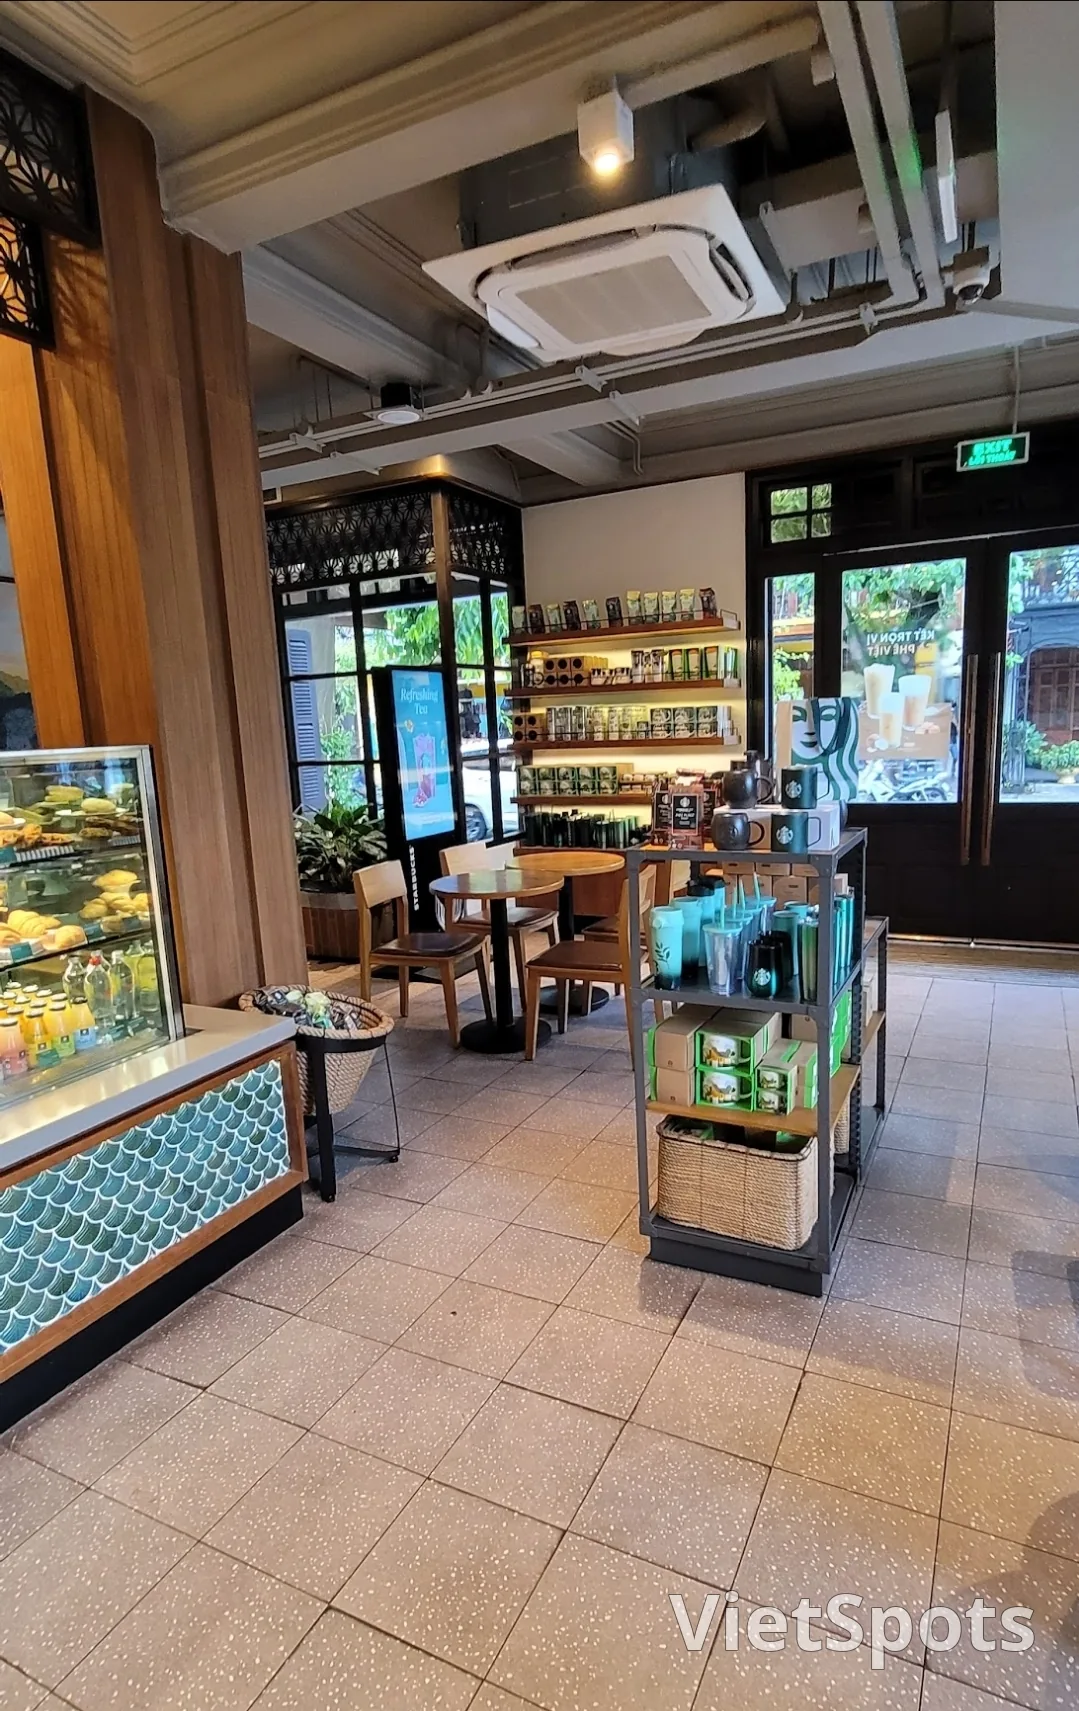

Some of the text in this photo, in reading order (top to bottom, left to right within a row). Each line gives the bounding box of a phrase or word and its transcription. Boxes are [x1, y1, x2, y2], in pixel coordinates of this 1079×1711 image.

[973, 439, 1012, 455] EXIT
[401, 688, 438, 703] Refreshing
[414, 702, 428, 715] Tea
[409, 845, 419, 911] STARBUCKS
